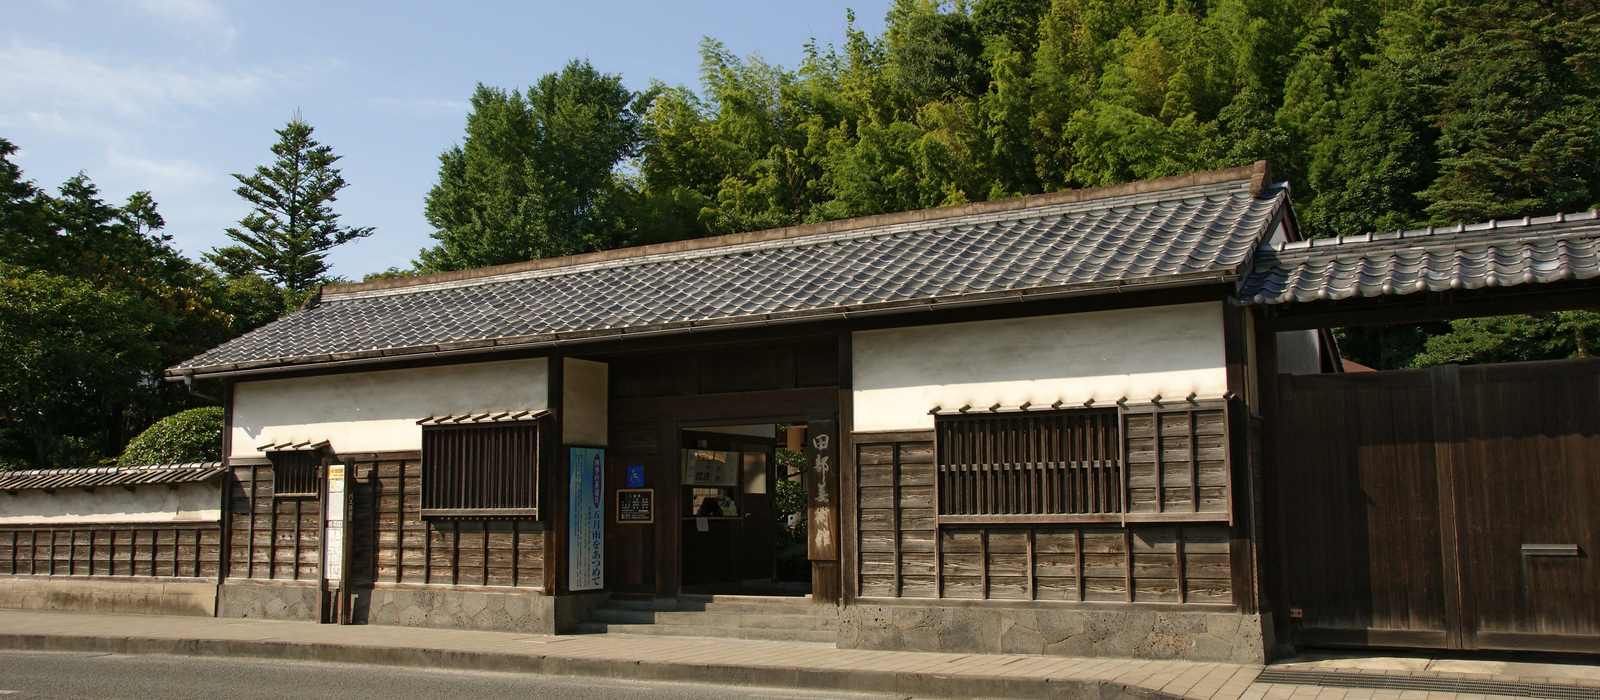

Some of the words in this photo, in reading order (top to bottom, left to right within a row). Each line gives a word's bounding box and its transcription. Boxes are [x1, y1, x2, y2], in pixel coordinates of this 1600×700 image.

[812, 434, 831, 547] 田部美術館
